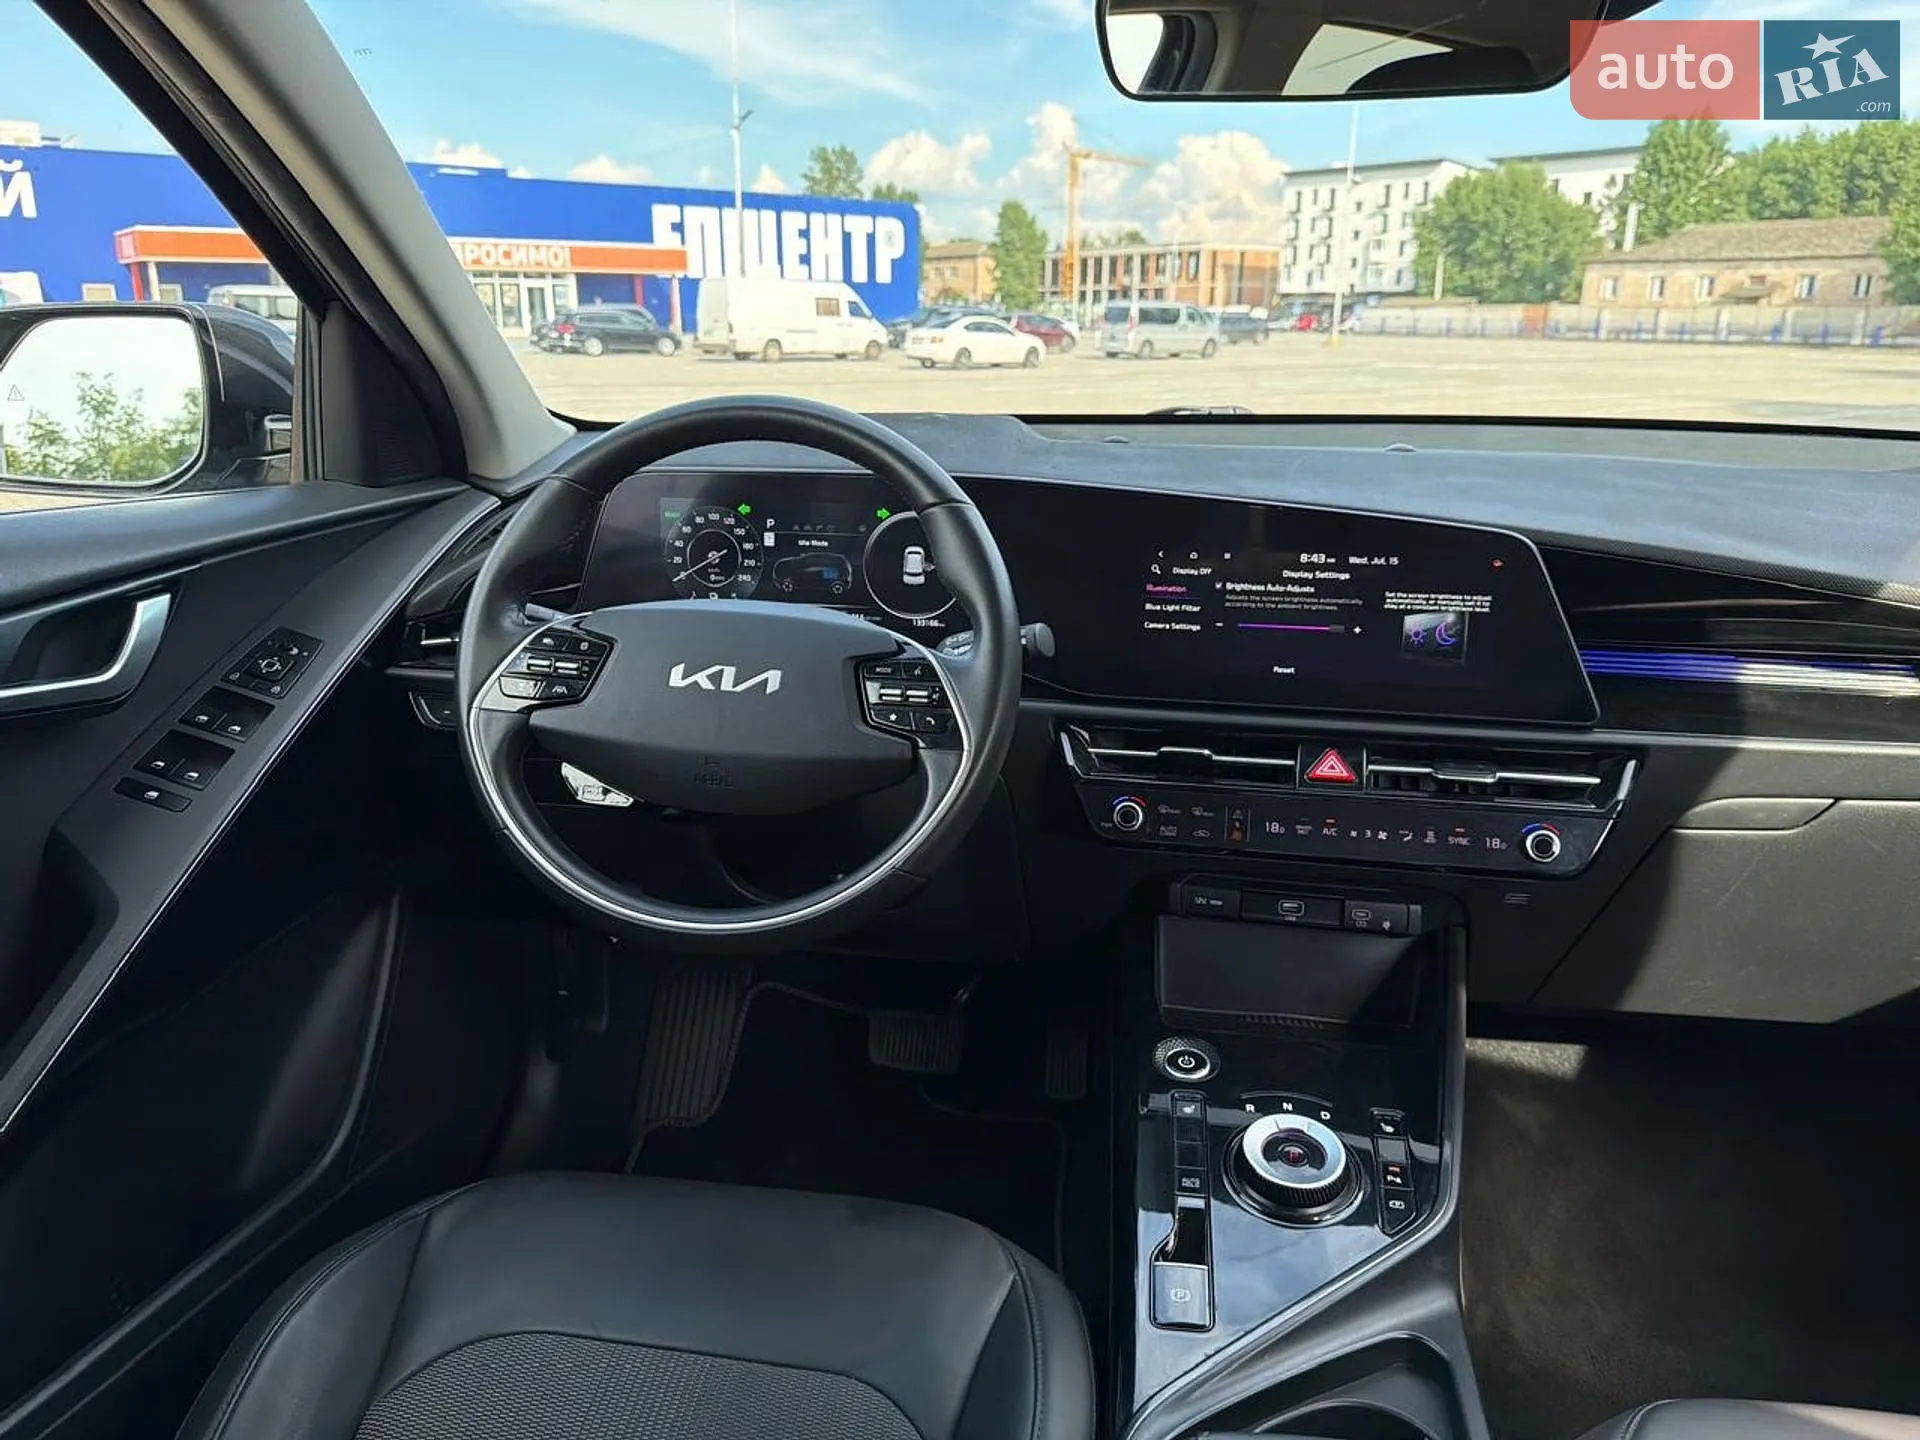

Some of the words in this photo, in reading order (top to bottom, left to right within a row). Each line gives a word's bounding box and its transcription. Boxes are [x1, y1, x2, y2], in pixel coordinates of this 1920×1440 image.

[766, 518, 775, 529] P
[1300, 552, 1326, 564] 8:43
[1173, 566, 1198, 575] Display
[1282, 569, 1312, 579] Display
[1314, 570, 1351, 580] Settings
[1226, 582, 1265, 591] Brightness
[1163, 604, 1180, 612] Light
[1144, 621, 1170, 629] Camera
[1171, 622, 1201, 631] Settings
[1273, 666, 1295, 675] Reset
[1364, 829, 1372, 838] 3
[1448, 836, 1470, 846] SYNC
[1246, 1103, 1256, 1113] R
[1283, 1102, 1293, 1112] N
[1320, 1110, 1331, 1120] D
